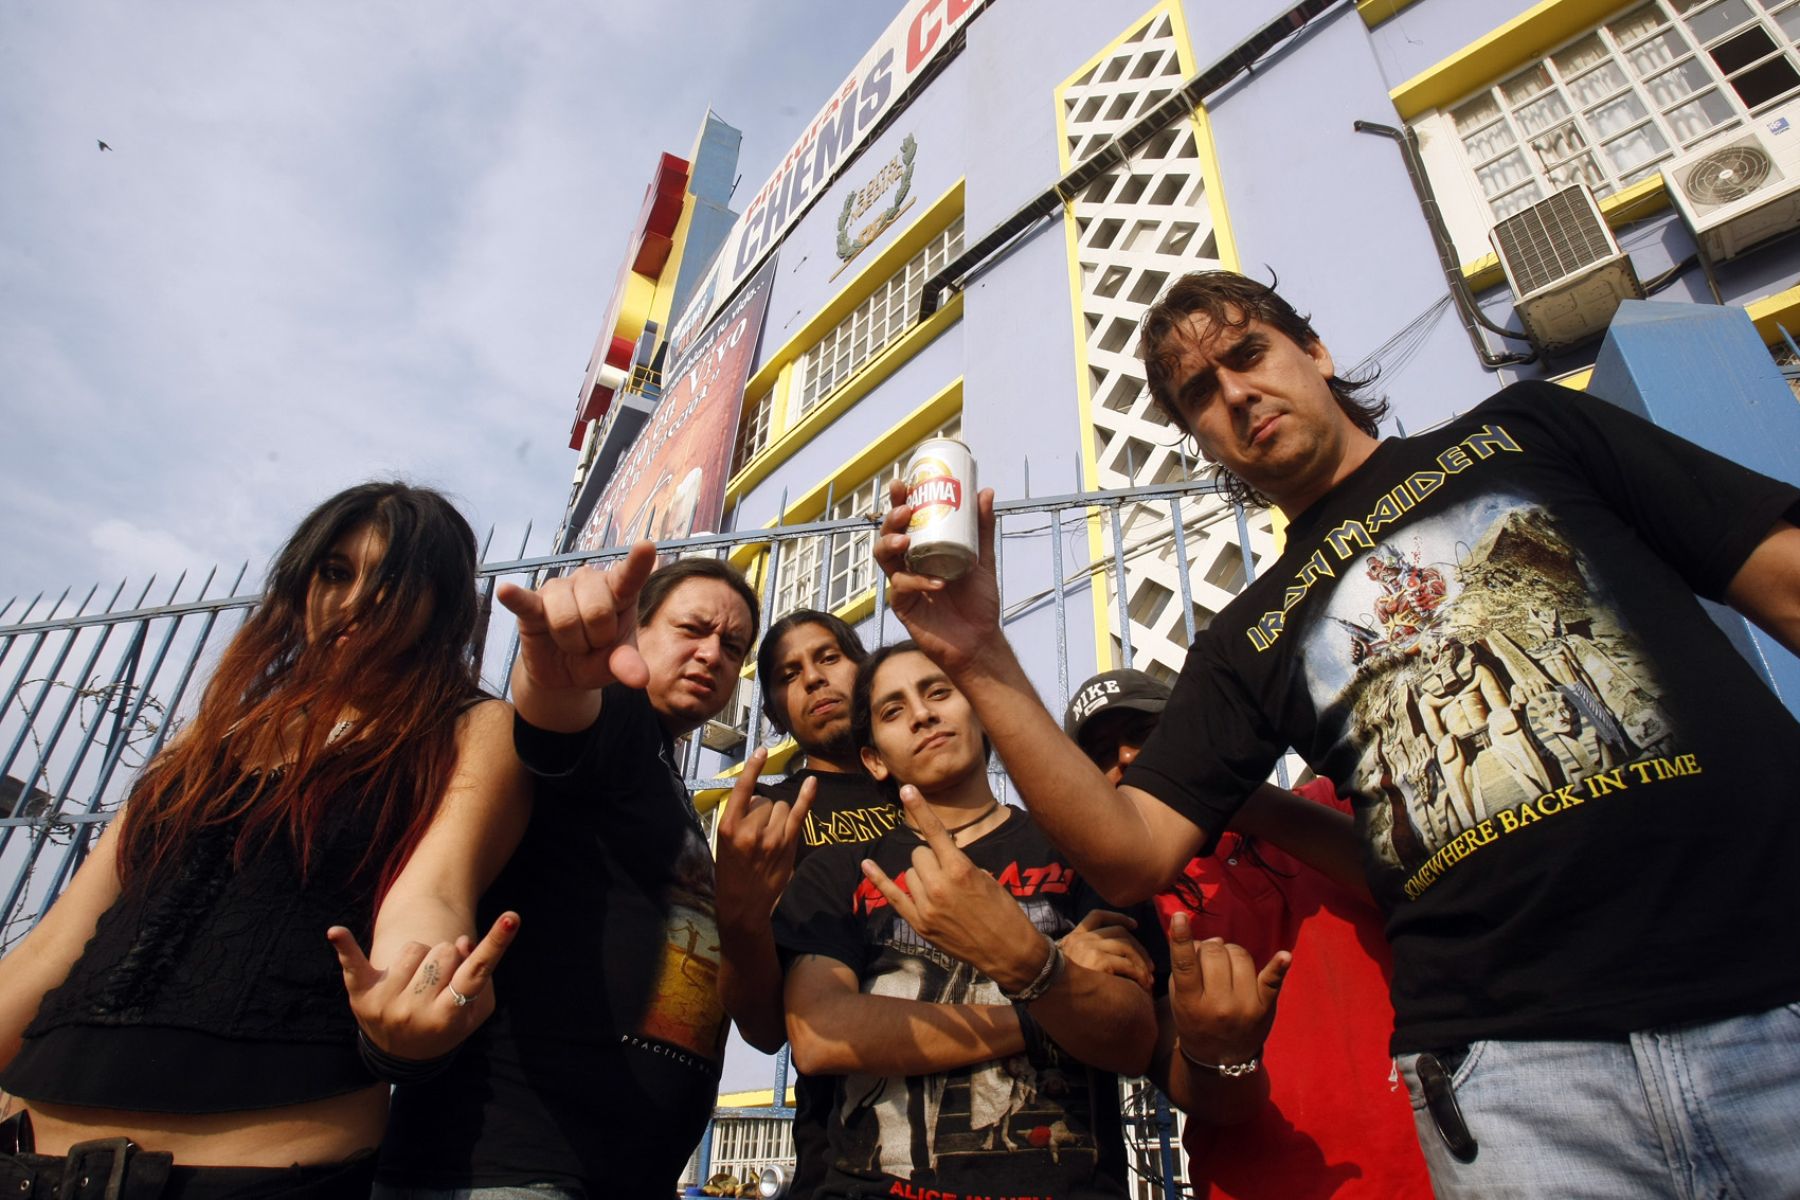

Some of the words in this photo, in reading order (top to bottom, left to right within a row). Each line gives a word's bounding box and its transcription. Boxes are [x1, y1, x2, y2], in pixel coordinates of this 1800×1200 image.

[732, 47, 895, 282] CHEMS
[745, 77, 857, 224] pinturas
[688, 317, 748, 396] Vivo
[1246, 549, 1336, 652] IRON
[1324, 423, 1524, 561] MAIDEN
[1072, 680, 1121, 722] NIKE
[1403, 819, 1500, 901] SOMEWHERE
[1497, 784, 1584, 834] BACK
[1583, 768, 1628, 799] IN
[1629, 753, 1703, 784] TIME
